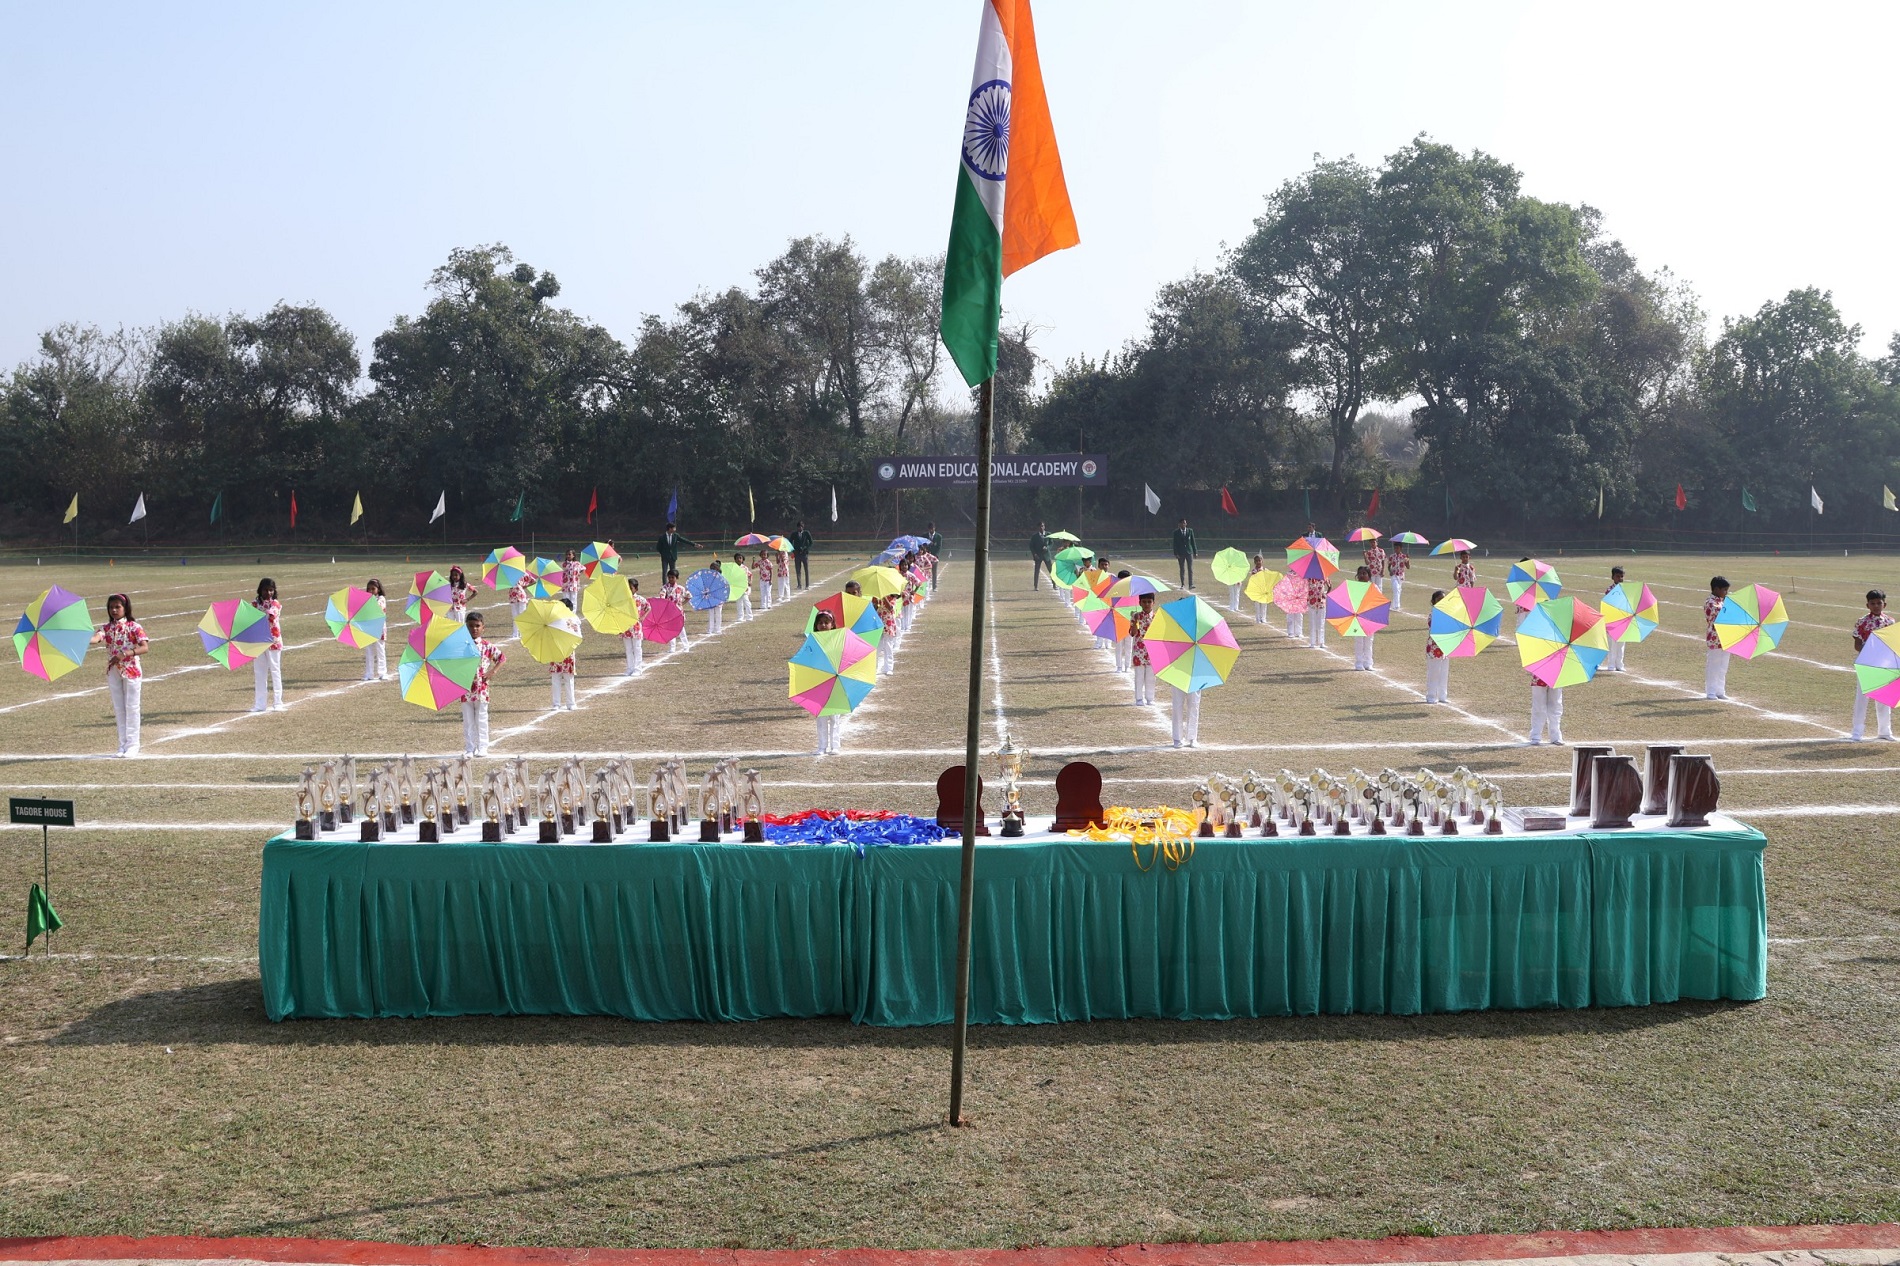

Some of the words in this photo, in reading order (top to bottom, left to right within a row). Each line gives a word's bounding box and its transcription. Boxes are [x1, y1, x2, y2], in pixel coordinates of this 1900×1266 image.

[899, 463, 936, 478] AWAN
[939, 462, 1020, 477] EDUCAONAL
[1022, 461, 1078, 476] ACADEMY
[15, 806, 43, 817] TAGORE
[43, 807, 67, 818] HOUSE
